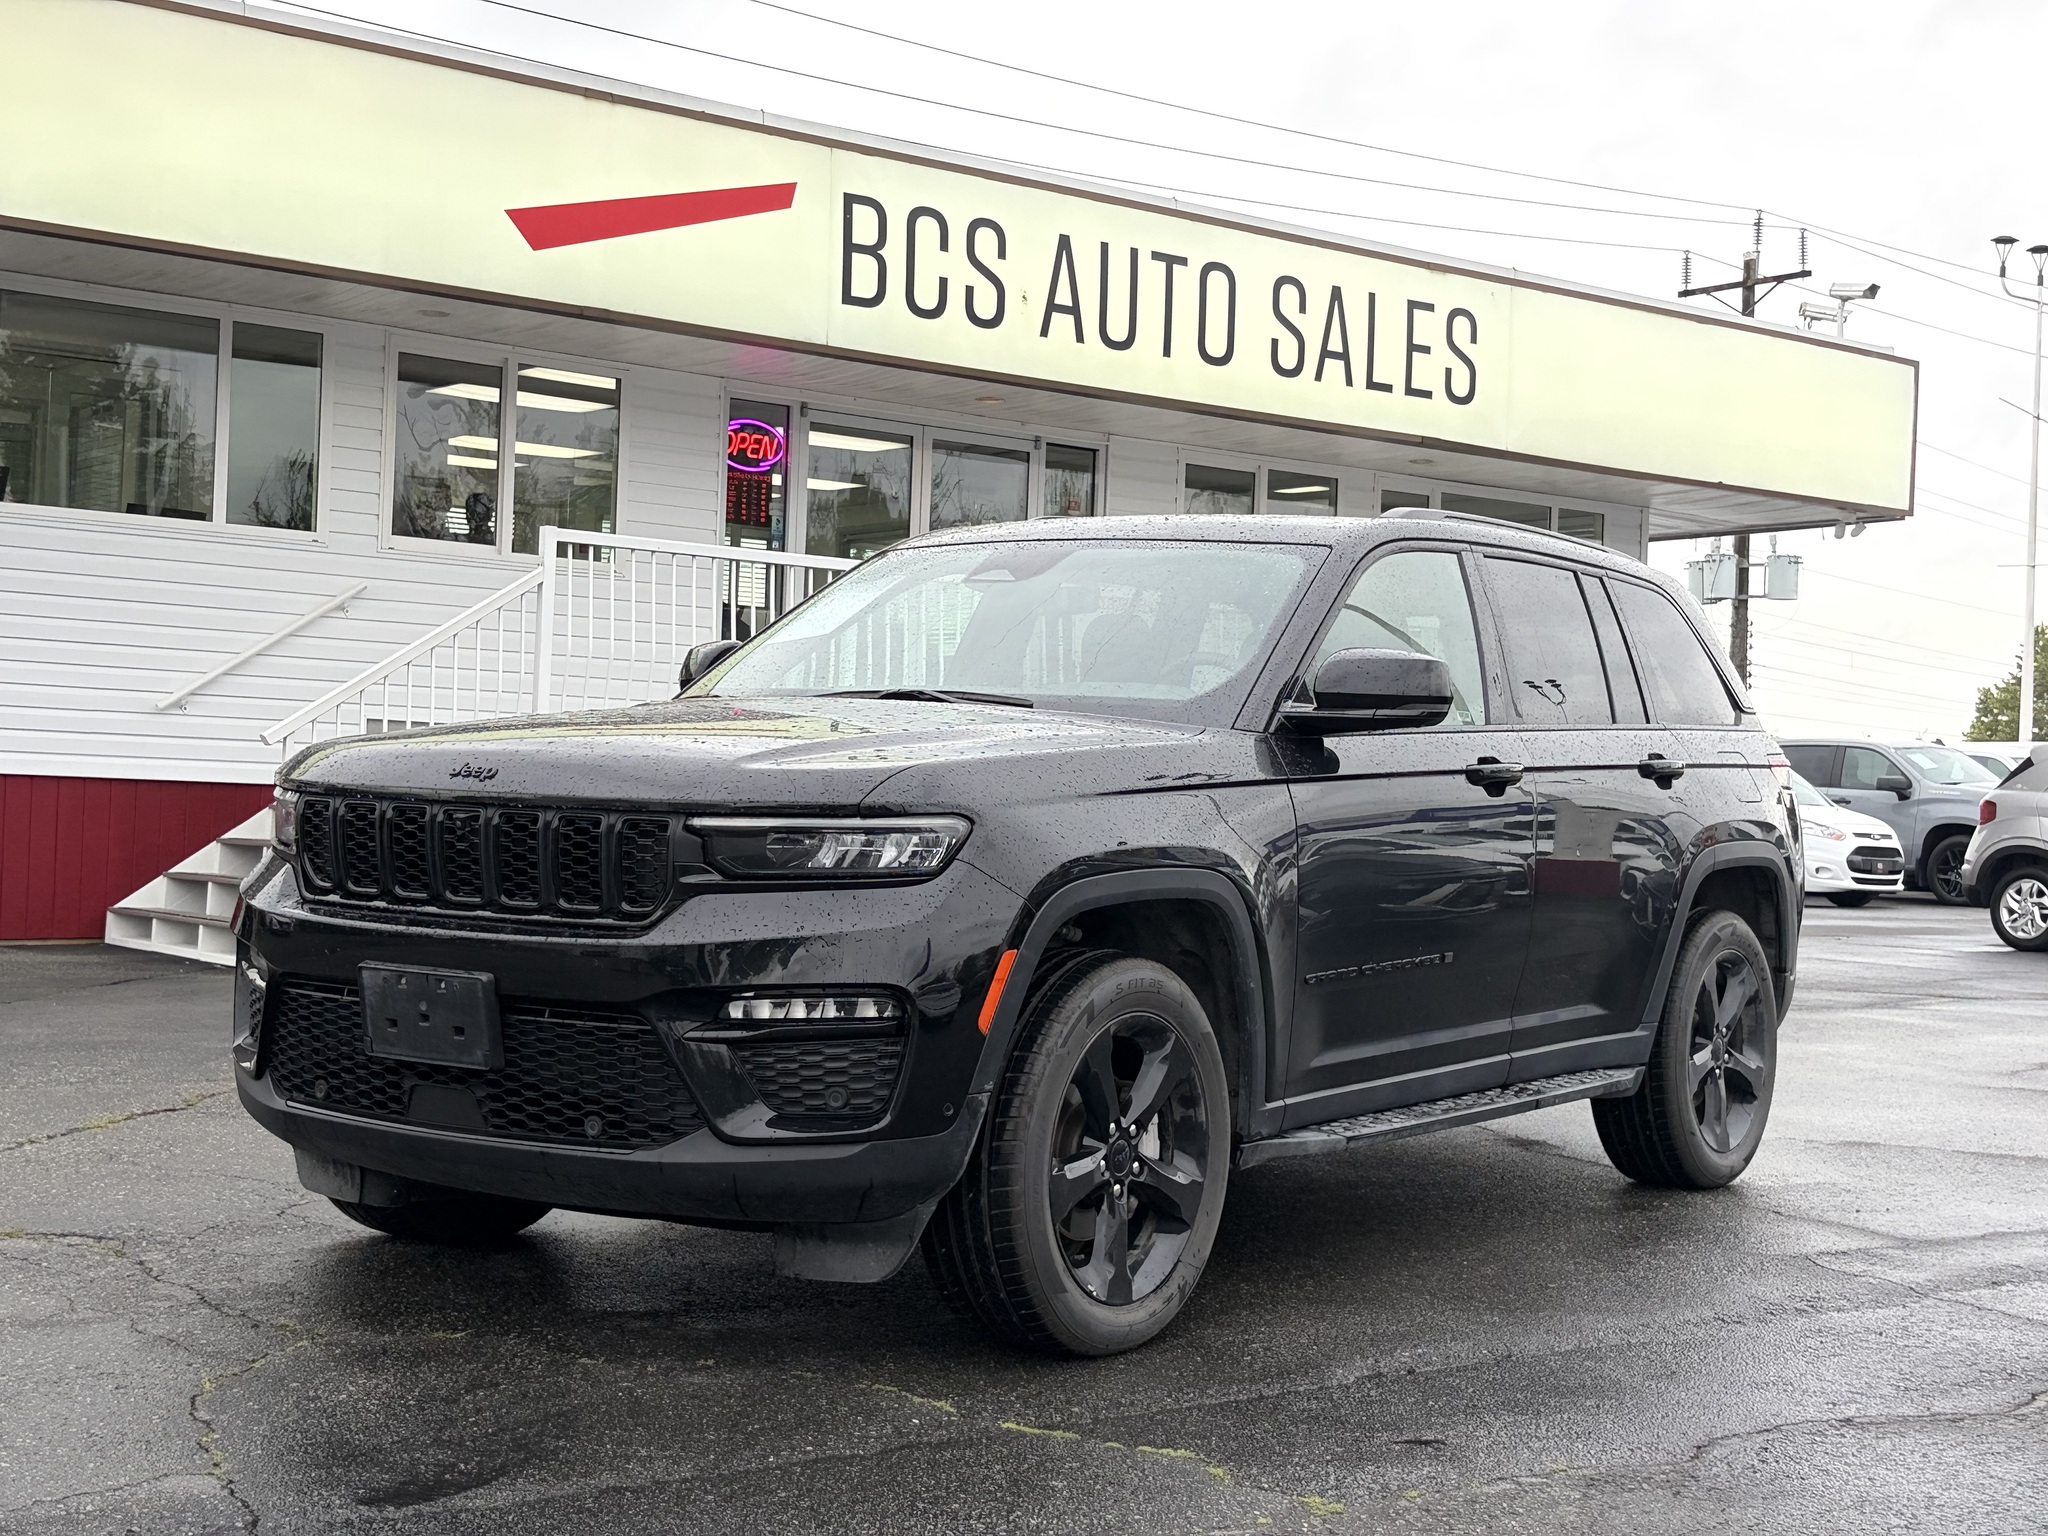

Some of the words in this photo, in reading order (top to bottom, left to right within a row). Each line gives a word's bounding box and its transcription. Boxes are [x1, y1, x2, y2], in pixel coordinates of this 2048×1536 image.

[842, 192, 1006, 329] BCS
[1039, 234, 1236, 366] AUTO
[1271, 275, 1477, 405] SALES
[449, 762, 499, 782] Jeep
